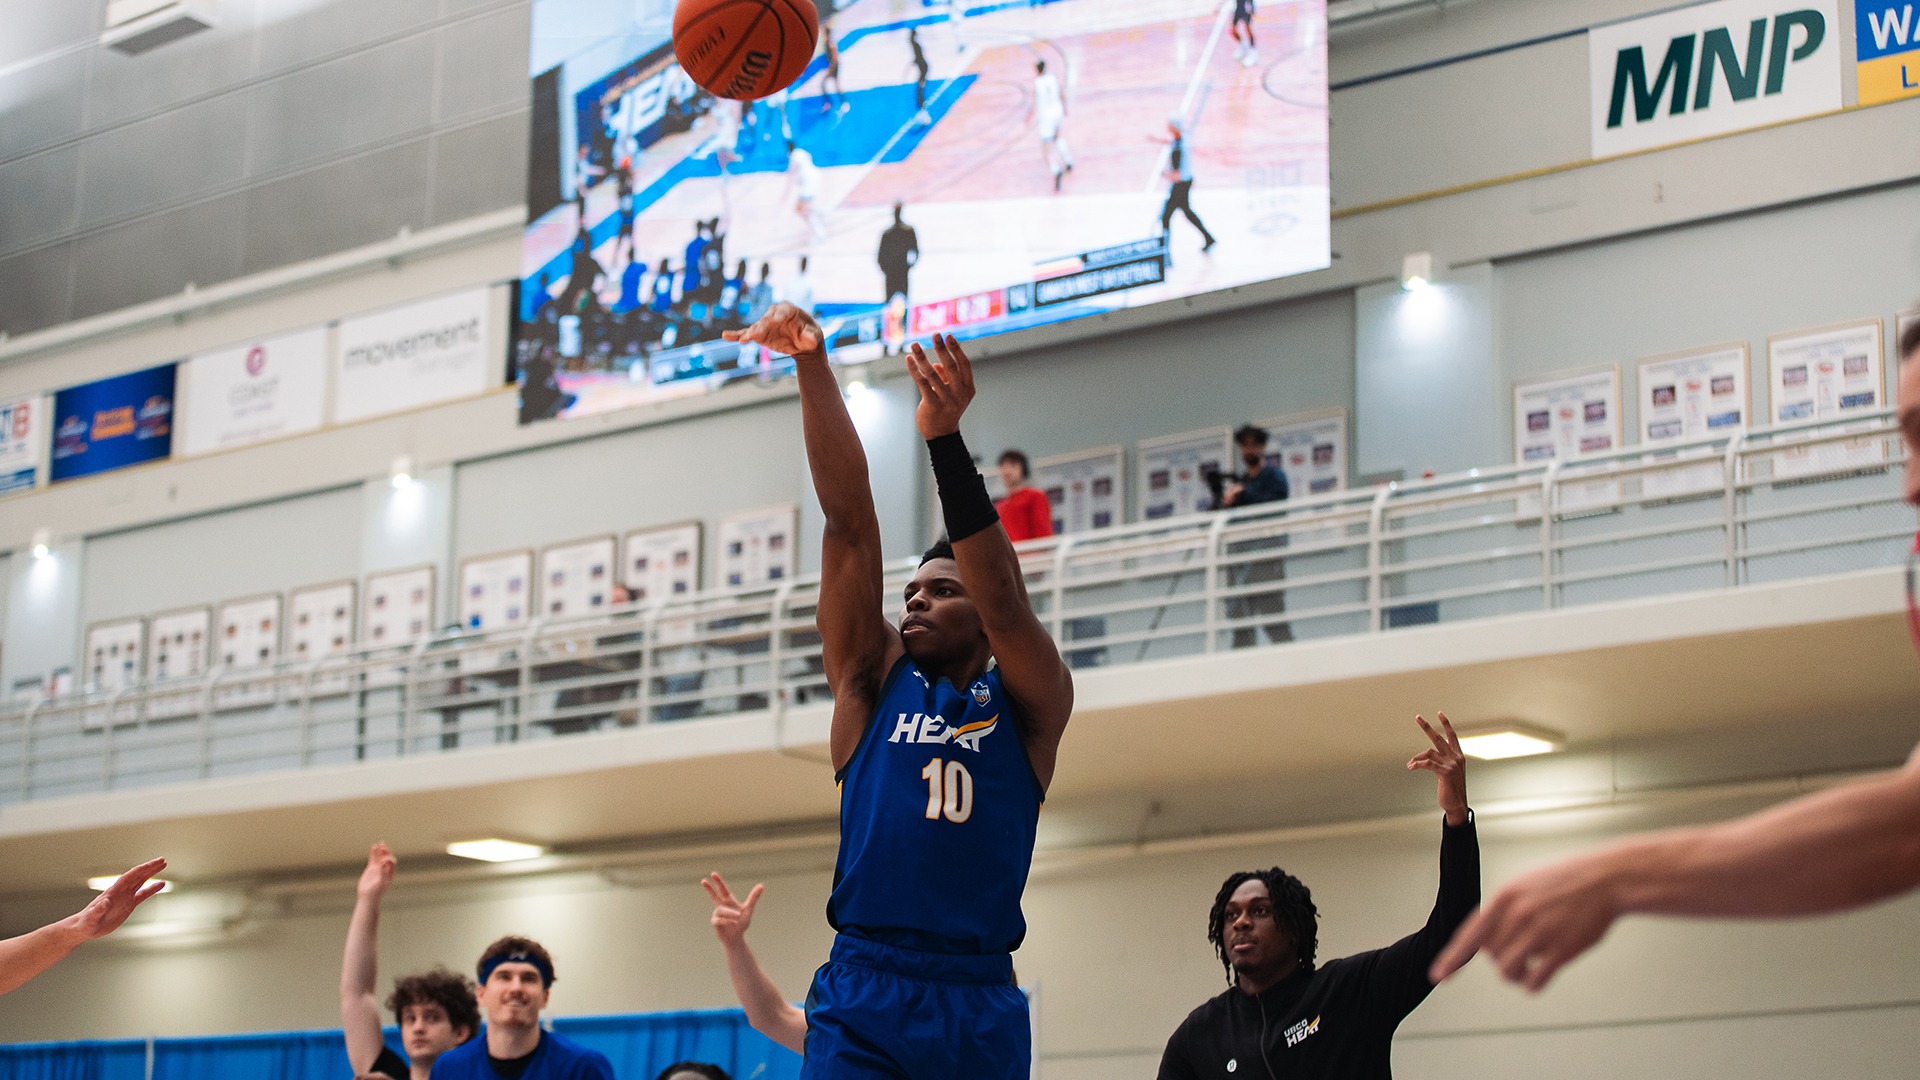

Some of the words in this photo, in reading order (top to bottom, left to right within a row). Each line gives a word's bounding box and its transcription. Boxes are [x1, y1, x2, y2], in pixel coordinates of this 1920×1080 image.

[683, 24, 726, 71] EVOLU
[1606, 9, 1826, 129] MNP
[343, 317, 479, 371] movement
[888, 713, 999, 753] HEAT
[922, 757, 973, 823] 10
[1284, 1018, 1308, 1037] UBCO
[1286, 1014, 1320, 1048] HEAT
